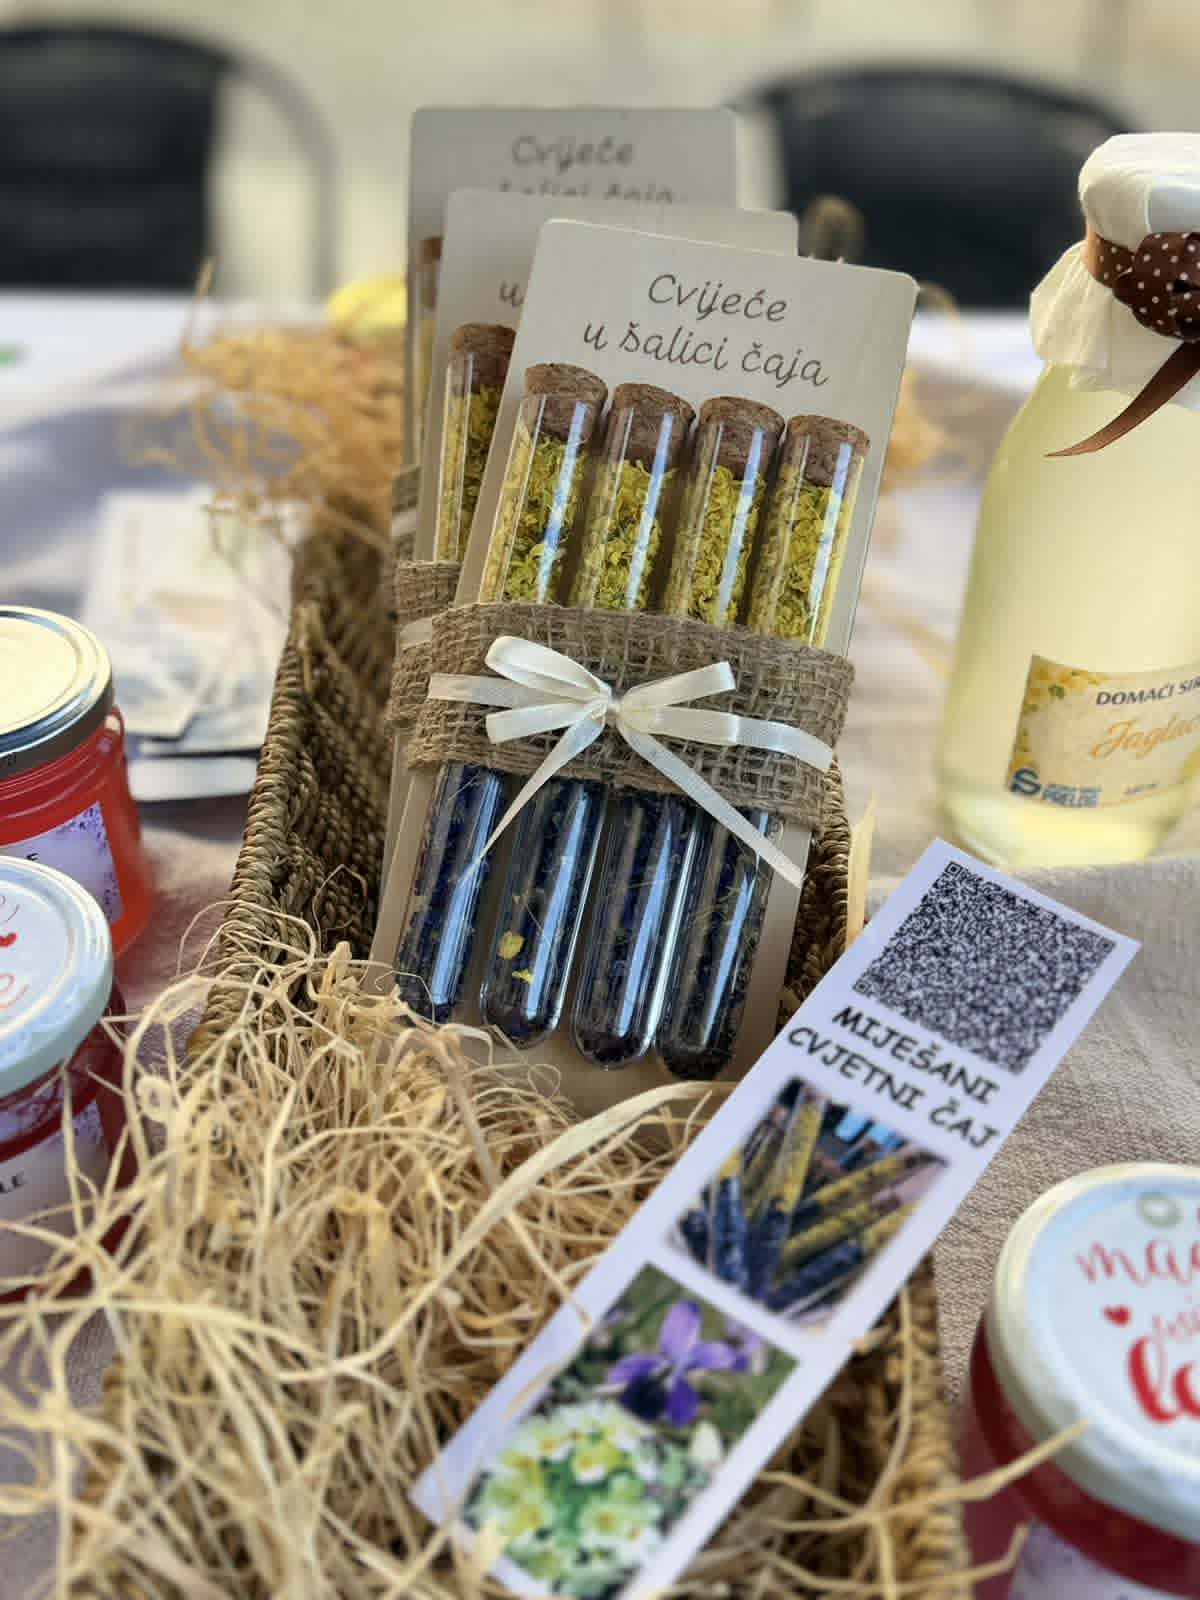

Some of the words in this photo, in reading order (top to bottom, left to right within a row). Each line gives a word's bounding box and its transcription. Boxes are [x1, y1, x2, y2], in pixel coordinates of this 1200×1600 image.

[647, 273, 788, 321] Cvijeće
[583, 322, 609, 351] u
[618, 321, 729, 371] šalici
[740, 343, 830, 389] čaja
[787, 1026, 925, 1111] CVJETNI
[929, 1097, 1000, 1148] ČAJ
[832, 1005, 1000, 1105] MIJEŠANI
